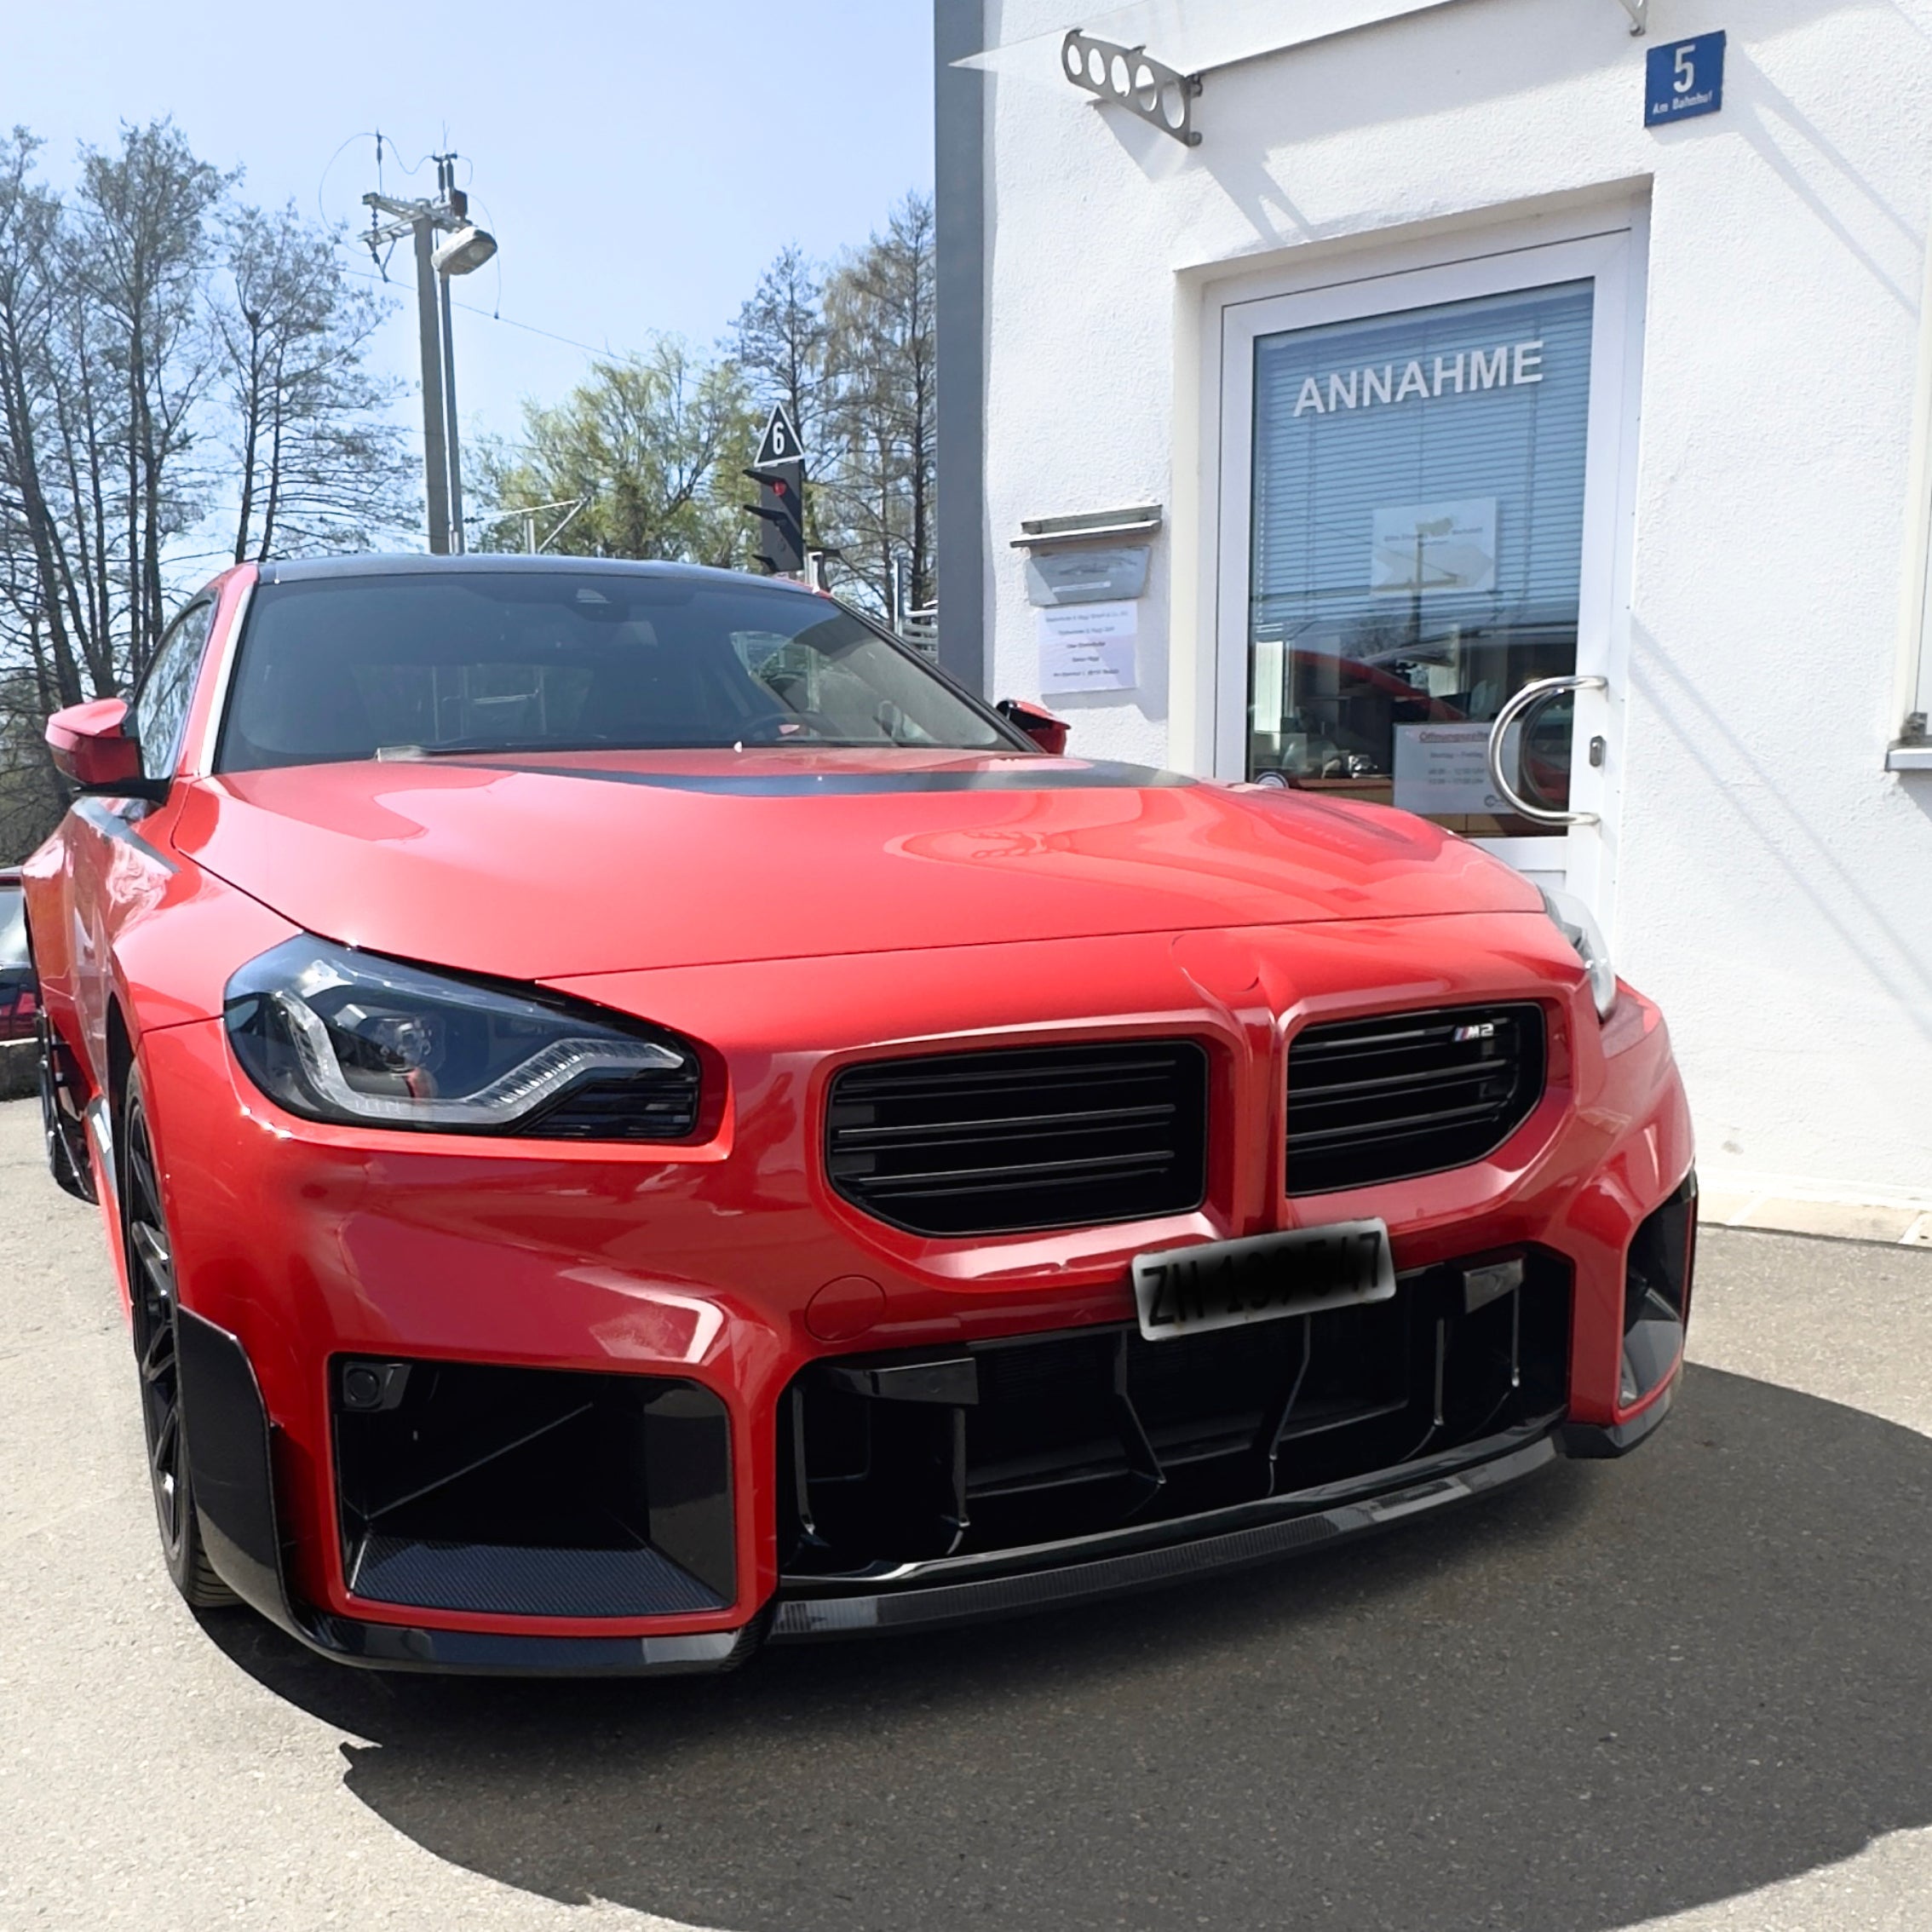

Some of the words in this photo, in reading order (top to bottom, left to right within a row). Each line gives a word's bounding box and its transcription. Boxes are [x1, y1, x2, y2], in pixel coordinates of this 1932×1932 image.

[1673, 44, 1695, 93] 5
[1652, 102, 1669, 115] Am
[1292, 341, 1544, 417] ANNAHME
[773, 422, 785, 455] 6
[1462, 1023, 1494, 1038] M2
